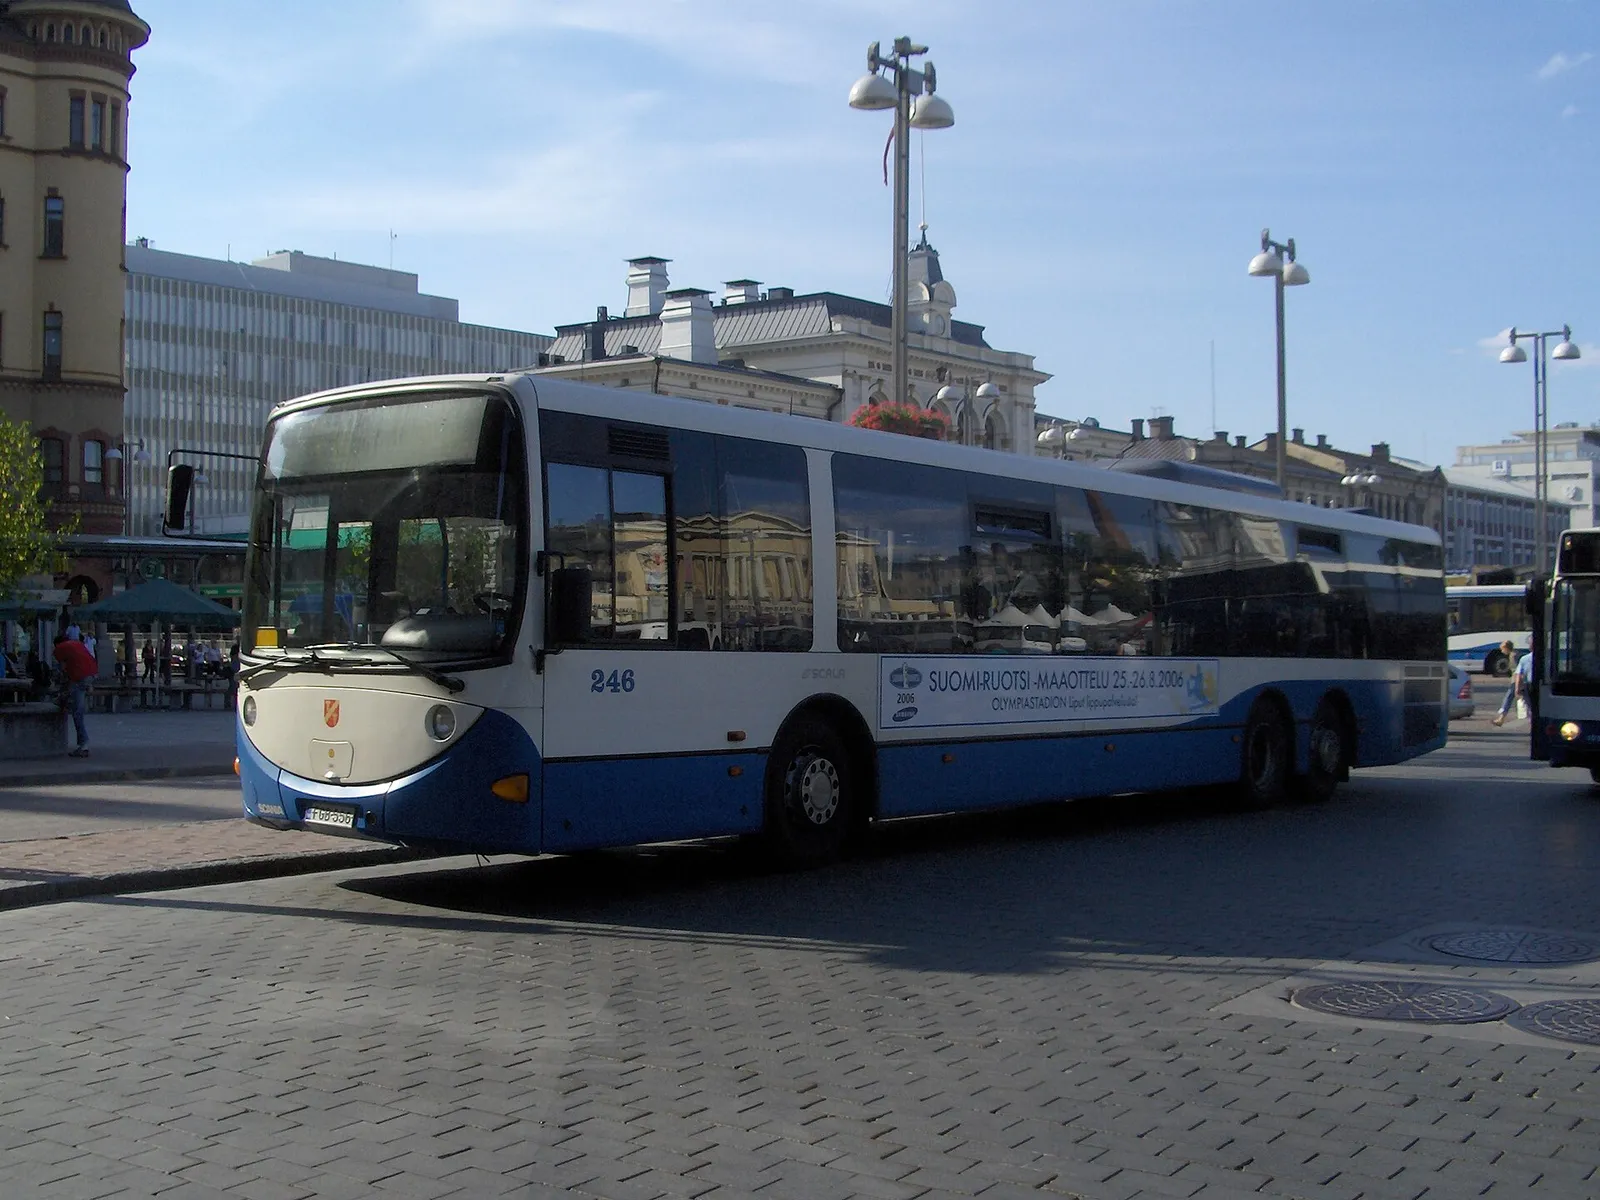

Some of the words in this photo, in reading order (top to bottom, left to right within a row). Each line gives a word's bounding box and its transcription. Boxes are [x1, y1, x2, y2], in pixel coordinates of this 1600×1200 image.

[812, 667, 845, 679] SCALA
[591, 669, 635, 693] 246
[929, 670, 1030, 692] SUOMI-RUOTSI
[897, 693, 915, 704] 2006
[991, 696, 1066, 711] OLYMPIASTADION
